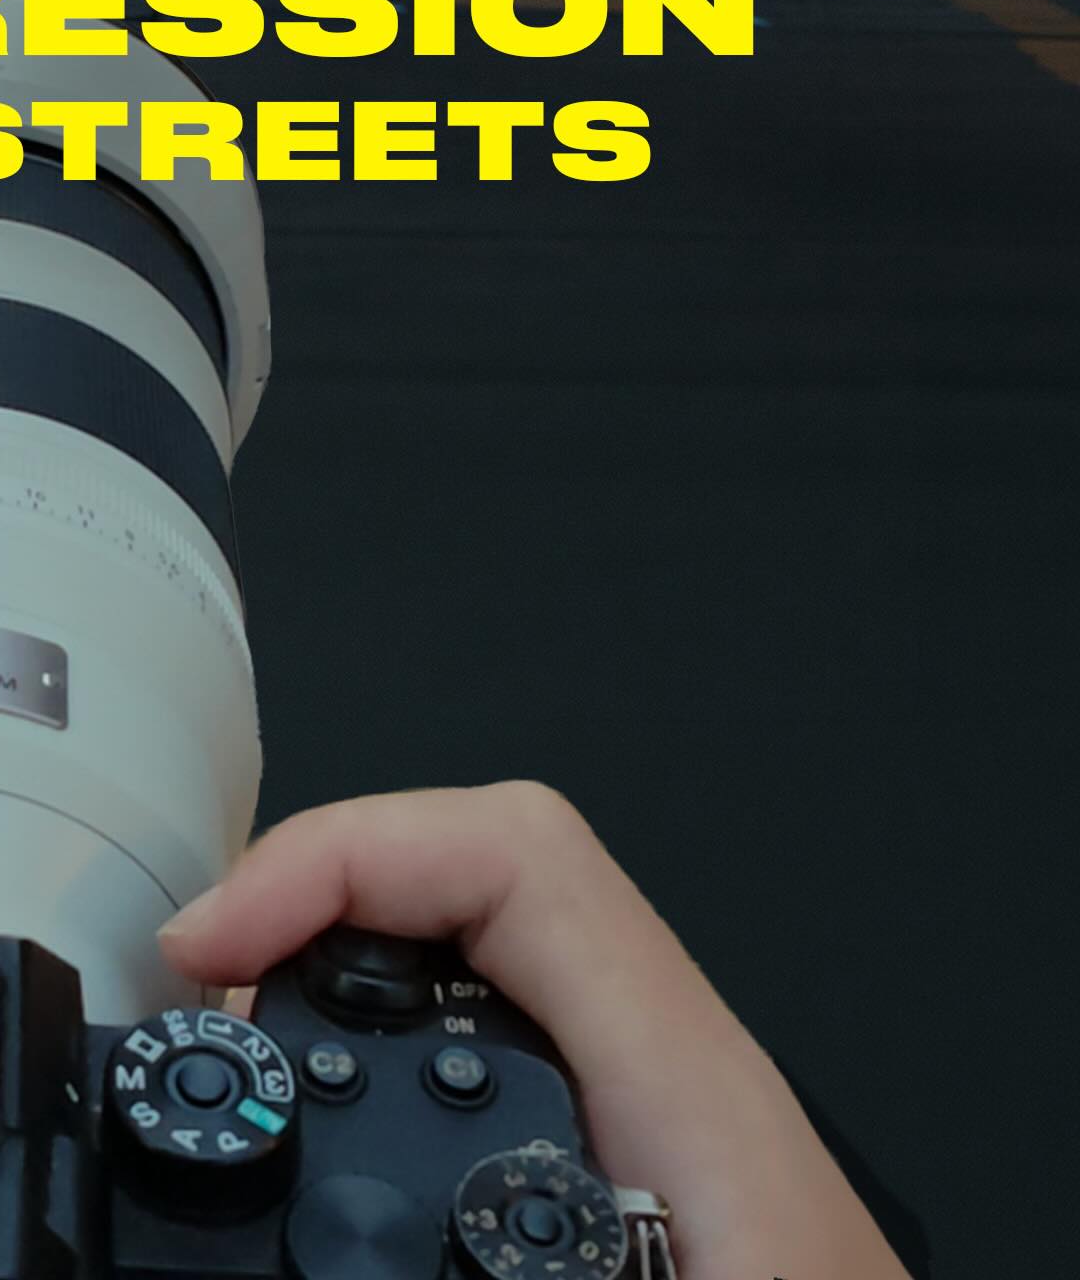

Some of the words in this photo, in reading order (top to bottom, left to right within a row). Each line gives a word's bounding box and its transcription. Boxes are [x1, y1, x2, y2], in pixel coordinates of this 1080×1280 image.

[444, 1016, 476, 1034] ON
[308, 1050, 354, 1074] C2
[442, 1055, 479, 1078] C1
[115, 1065, 146, 1089] M
[130, 1101, 161, 1128] S
[170, 1129, 202, 1152] A
[216, 1130, 250, 1153] P
